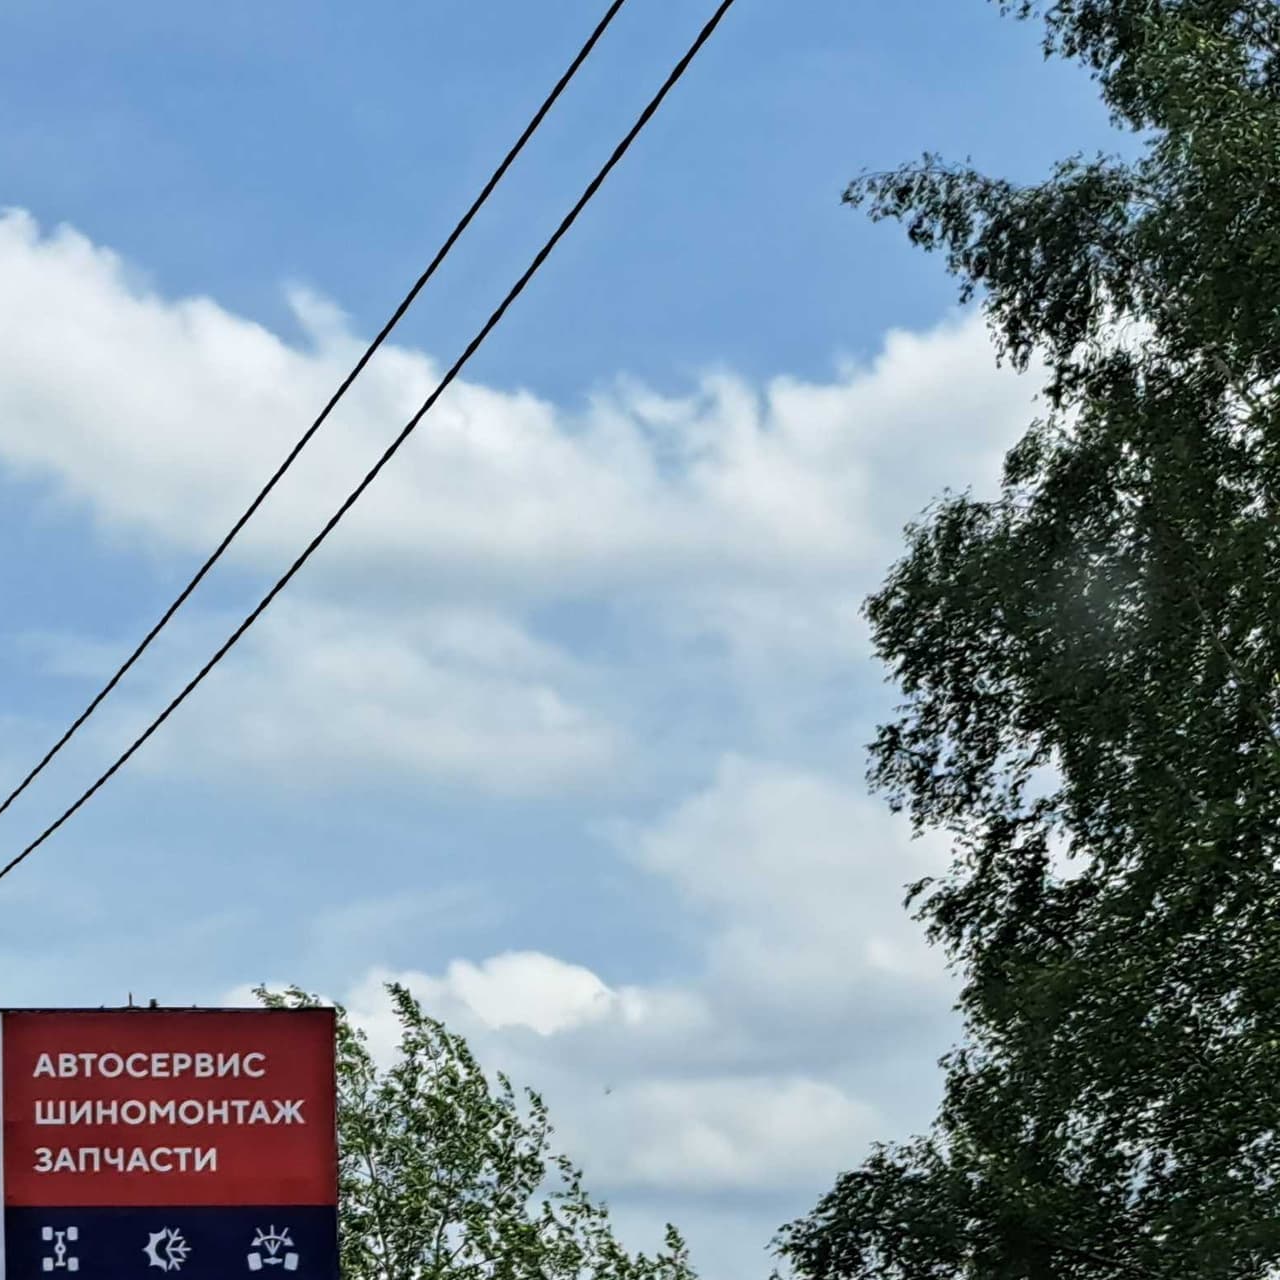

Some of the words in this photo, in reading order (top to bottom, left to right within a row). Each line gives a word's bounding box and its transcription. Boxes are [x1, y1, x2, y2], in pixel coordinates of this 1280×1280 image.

[32, 1052, 267, 1078] АВТОСЕРВИС
[34, 1099, 307, 1126] ШИНОМОНТАЖ
[32, 1147, 218, 1173] ЗАПЧАСТИ
